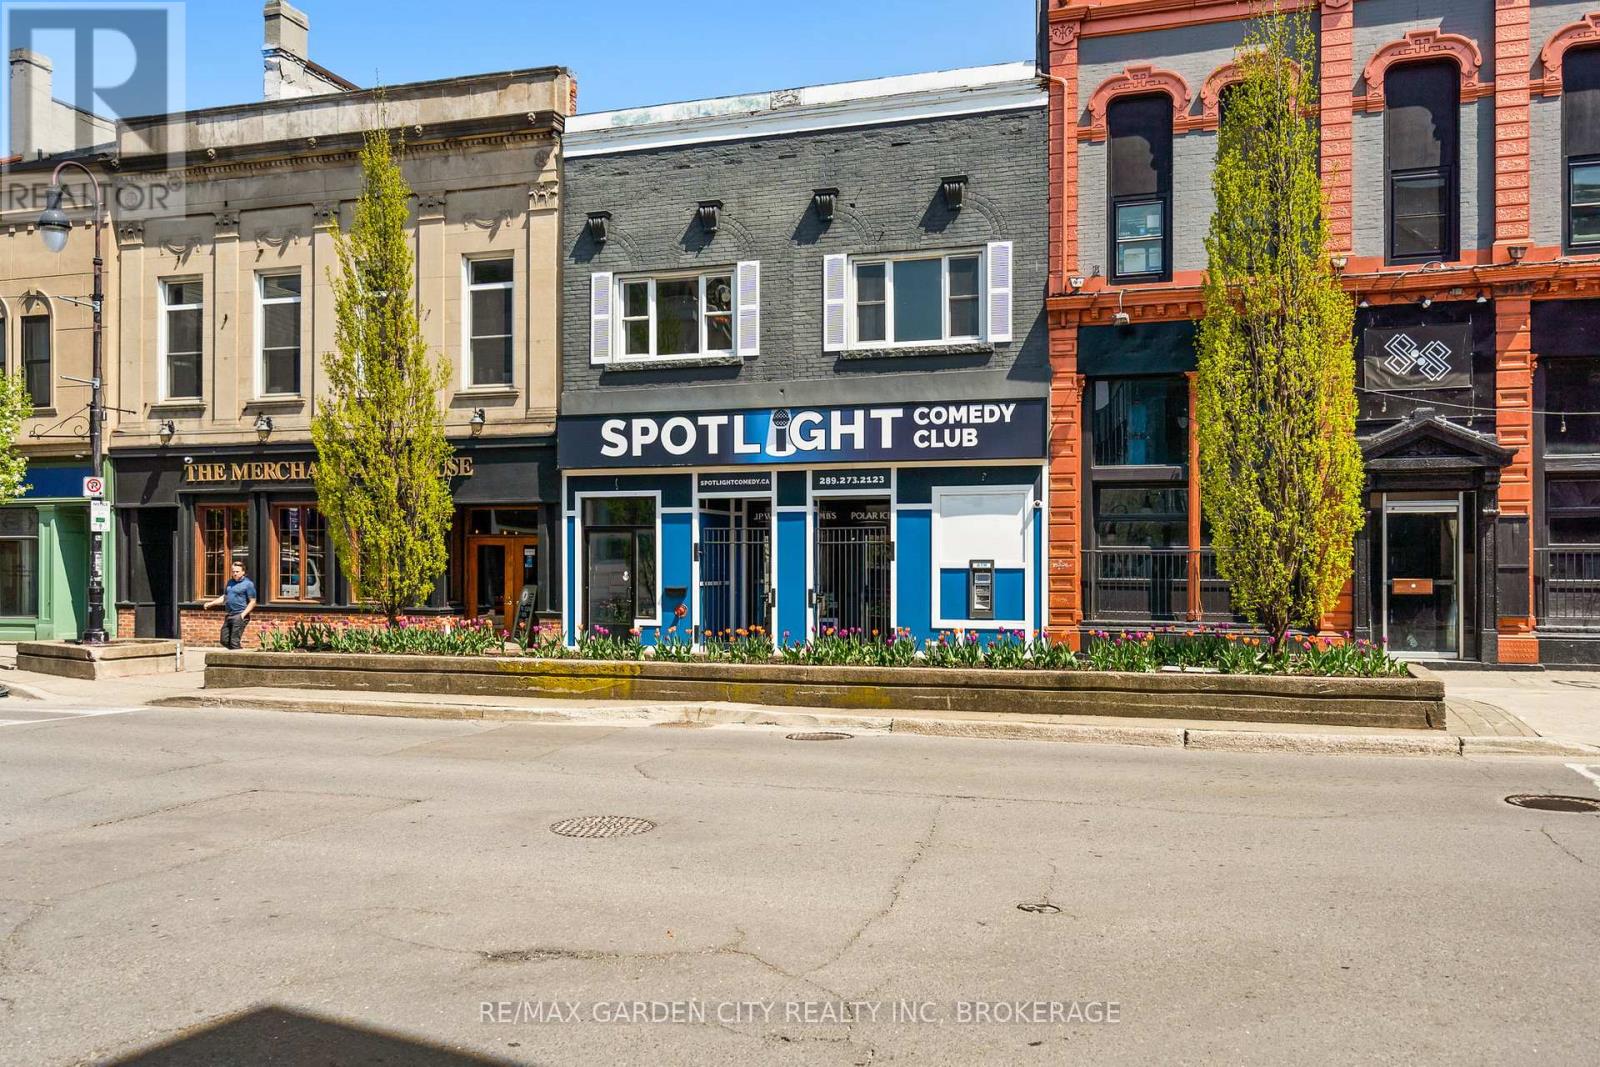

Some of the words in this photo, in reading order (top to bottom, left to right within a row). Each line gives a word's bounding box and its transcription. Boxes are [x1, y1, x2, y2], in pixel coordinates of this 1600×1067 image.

[913, 403, 1016, 426] COMEDY
[600, 408, 904, 457] SPOTLIGHT
[913, 428, 978, 448] CLUB
[184, 463, 227, 481] THE
[230, 461, 320, 480] MERCHA
[819, 475, 885, 485] 289.273.2123
[700, 478, 770, 486] SPOTLIGHTCOMEDY.CA
[851, 511, 878, 520] POLAR
